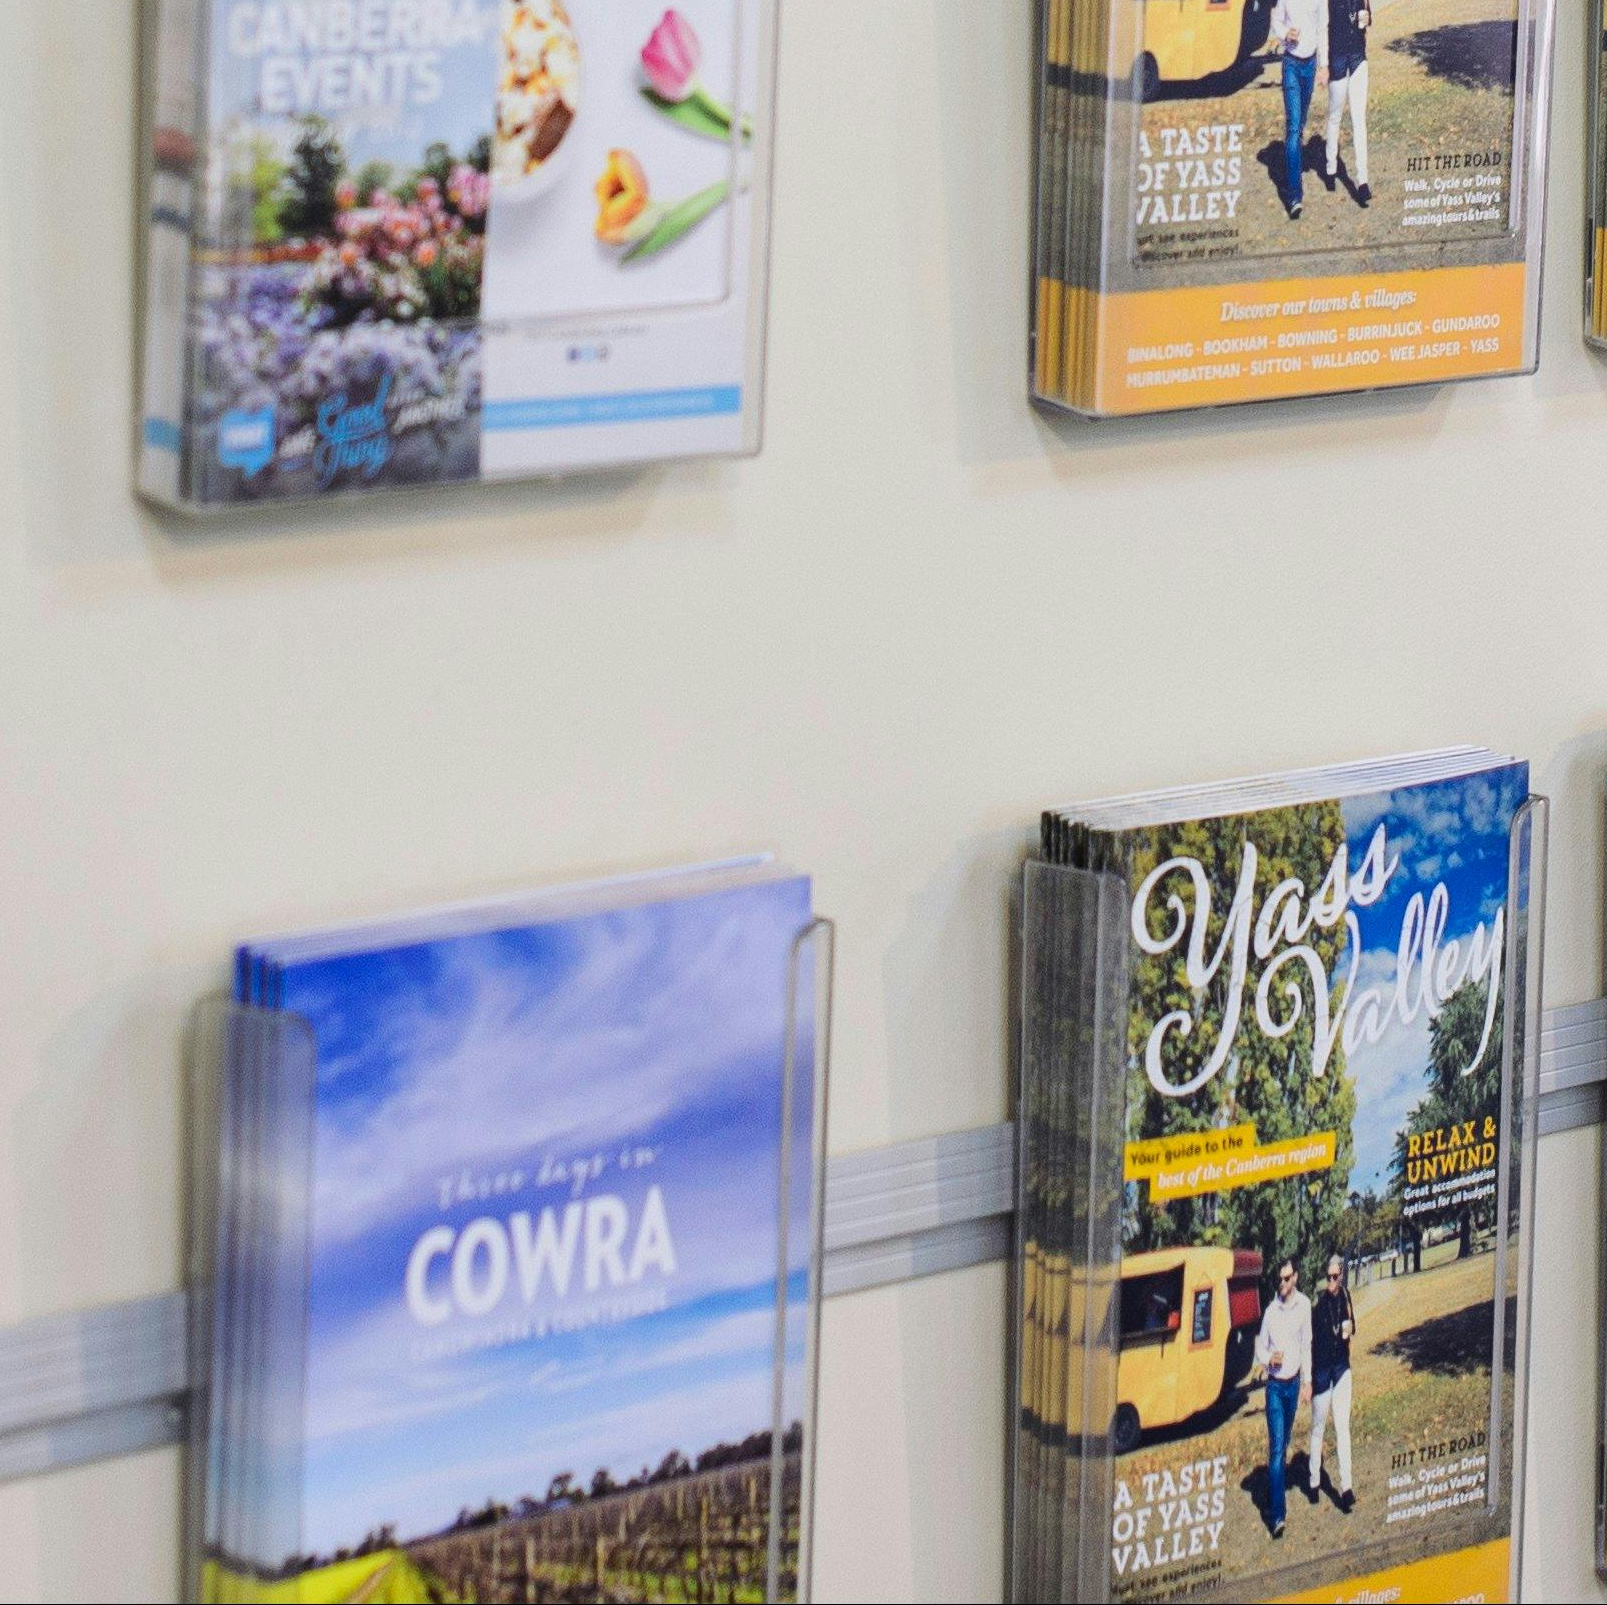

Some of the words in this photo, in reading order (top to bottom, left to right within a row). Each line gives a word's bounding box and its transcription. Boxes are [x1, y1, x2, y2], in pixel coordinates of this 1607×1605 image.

[259, 51, 443, 114] EVENTS
[1160, 124, 1244, 156] TASTE
[1407, 157, 1431, 172] HIT
[1434, 155, 1461, 170] THE
[1464, 151, 1501, 168] ROAD
[1175, 157, 1242, 189] YASS
[1404, 178, 1431, 193] Walk,
[1433, 177, 1460, 193] Cycle
[1463, 178, 1473, 188] or
[1475, 174, 1501, 187] Drive
[1403, 197, 1429, 210] some
[1430, 195, 1442, 207] of
[1442, 194, 1463, 207] Yass
[1464, 191, 1501, 206] Valley's
[1219, 301, 1280, 323] Discover
[1282, 299, 1306, 316] our
[1308, 295, 1348, 315] towns
[1349, 290, 1362, 310] &
[1364, 288, 1417, 311] villages:
[1127, 343, 1194, 364] BINALONG
[1202, 335, 1269, 356] BOOKHAM
[1277, 328, 1338, 349] BOWNING
[1347, 320, 1423, 343] BURRINJUCK
[1431, 313, 1501, 334] GUNDAROO
[1126, 362, 1241, 389] MURRUMBATEMAN
[1249, 356, 1302, 377] SUTTON
[1311, 348, 1380, 370] WALLAROO
[1389, 346, 1415, 362] WEE
[1417, 341, 1461, 360] JASPER
[1470, 336, 1499, 354] YASS
[1131, 823, 1399, 1096] Yass
[1254, 881, 1506, 1078] Valley
[1130, 1151, 1161, 1166] Your
[1165, 1145, 1202, 1164] guide
[1205, 1141, 1218, 1154] to
[1222, 1136, 1243, 1151] the
[1407, 1120, 1476, 1158] RELAX
[1483, 1115, 1497, 1139] &
[1157, 1171, 1185, 1190] best
[1187, 1165, 1202, 1187] of
[1202, 1162, 1222, 1181] the
[1225, 1151, 1286, 1177] Canberra
[1288, 1143, 1327, 1165] region
[1407, 1142, 1496, 1185] UNWIND
[405, 1184, 676, 1328] COWRA
[1391, 1450, 1416, 1470] HIT
[1418, 1442, 1446, 1462] THE
[1449, 1432, 1487, 1455] ROAD
[1113, 1480, 1133, 1512] A
[1142, 1454, 1229, 1503] TASTE
[1112, 1506, 1152, 1543] OF
[1157, 1487, 1226, 1532] YASS
[1111, 1520, 1225, 1576] VALLEY
